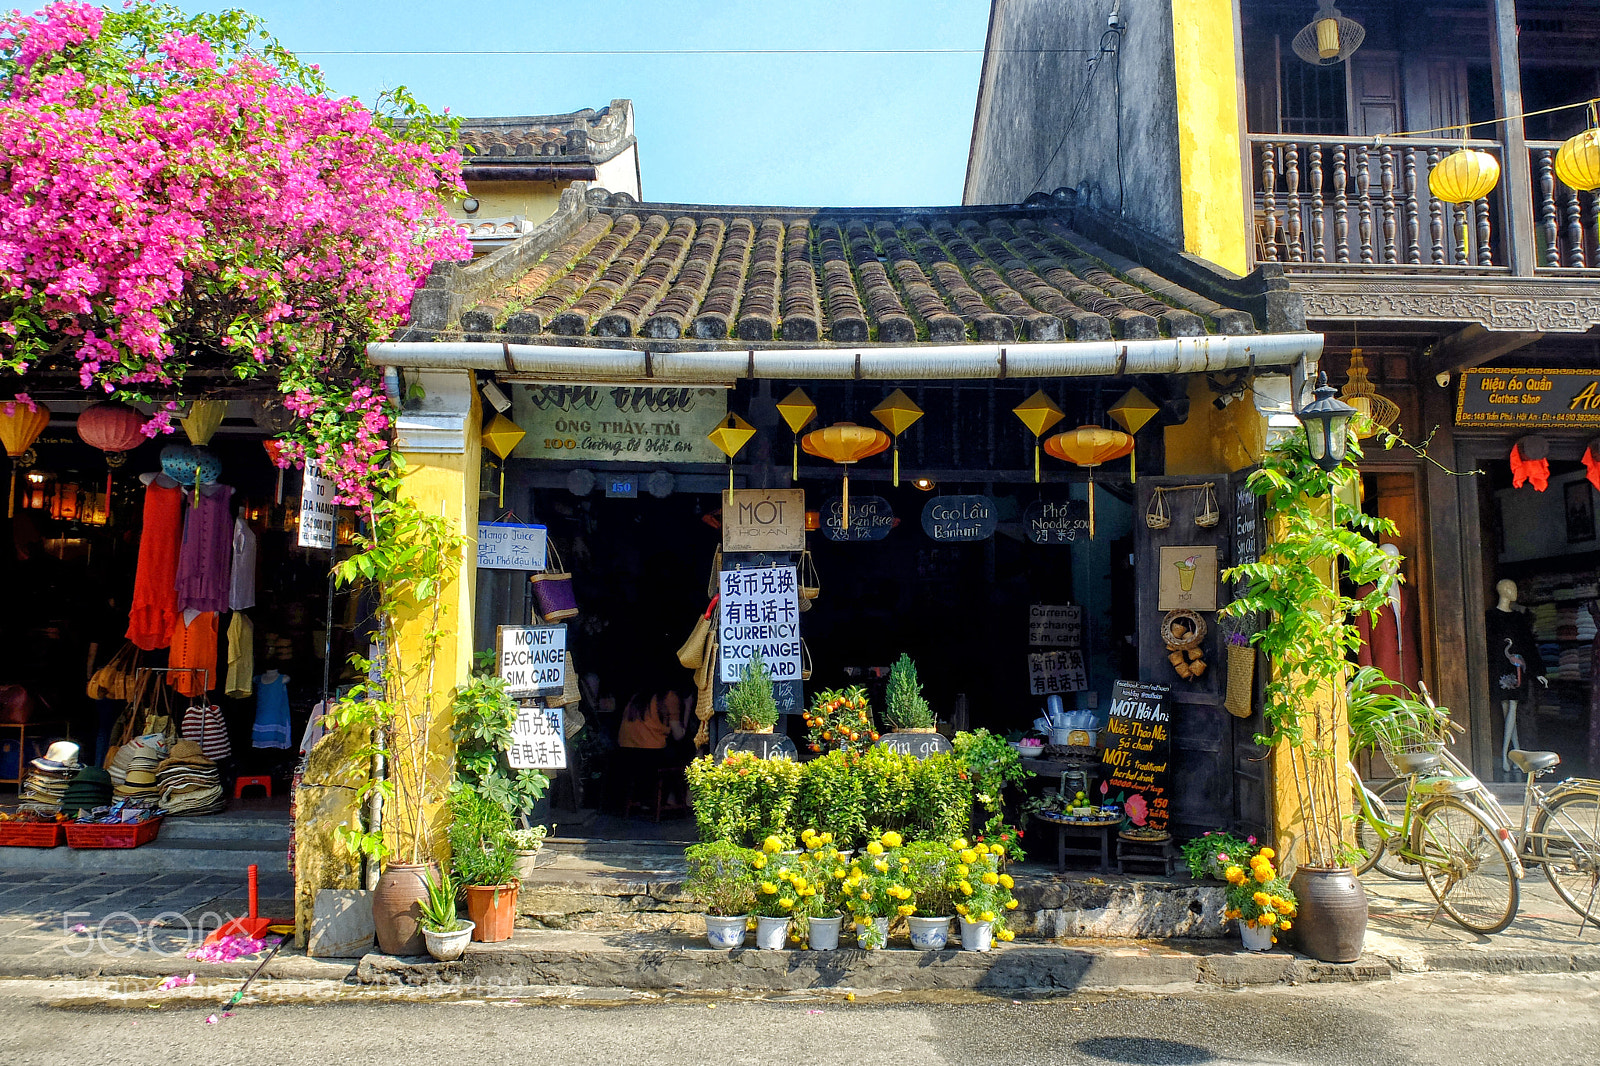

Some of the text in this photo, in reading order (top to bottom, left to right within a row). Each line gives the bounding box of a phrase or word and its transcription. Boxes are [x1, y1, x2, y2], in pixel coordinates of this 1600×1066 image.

[1489, 394, 1542, 404] Clothes Shop
[316, 484, 324, 496] TO
[612, 482, 631, 493] 150
[303, 500, 314, 512] DA
[739, 496, 787, 525] MÓT
[932, 504, 960, 520] Cao
[479, 530, 534, 543] Mango Juice
[725, 570, 795, 596] 货币兑换
[726, 598, 796, 625] 有电话卡
[1031, 608, 1080, 620] Currency
[723, 624, 797, 641] CURRENCY
[1030, 621, 1080, 632] exchange
[515, 630, 554, 646] MONEY
[1056, 634, 1080, 642] card
[504, 649, 564, 666] EXCHANGE
[723, 643, 800, 659] EXCHANGE
[531, 669, 560, 684] CARD
[510, 741, 562, 766] 有电话卡
